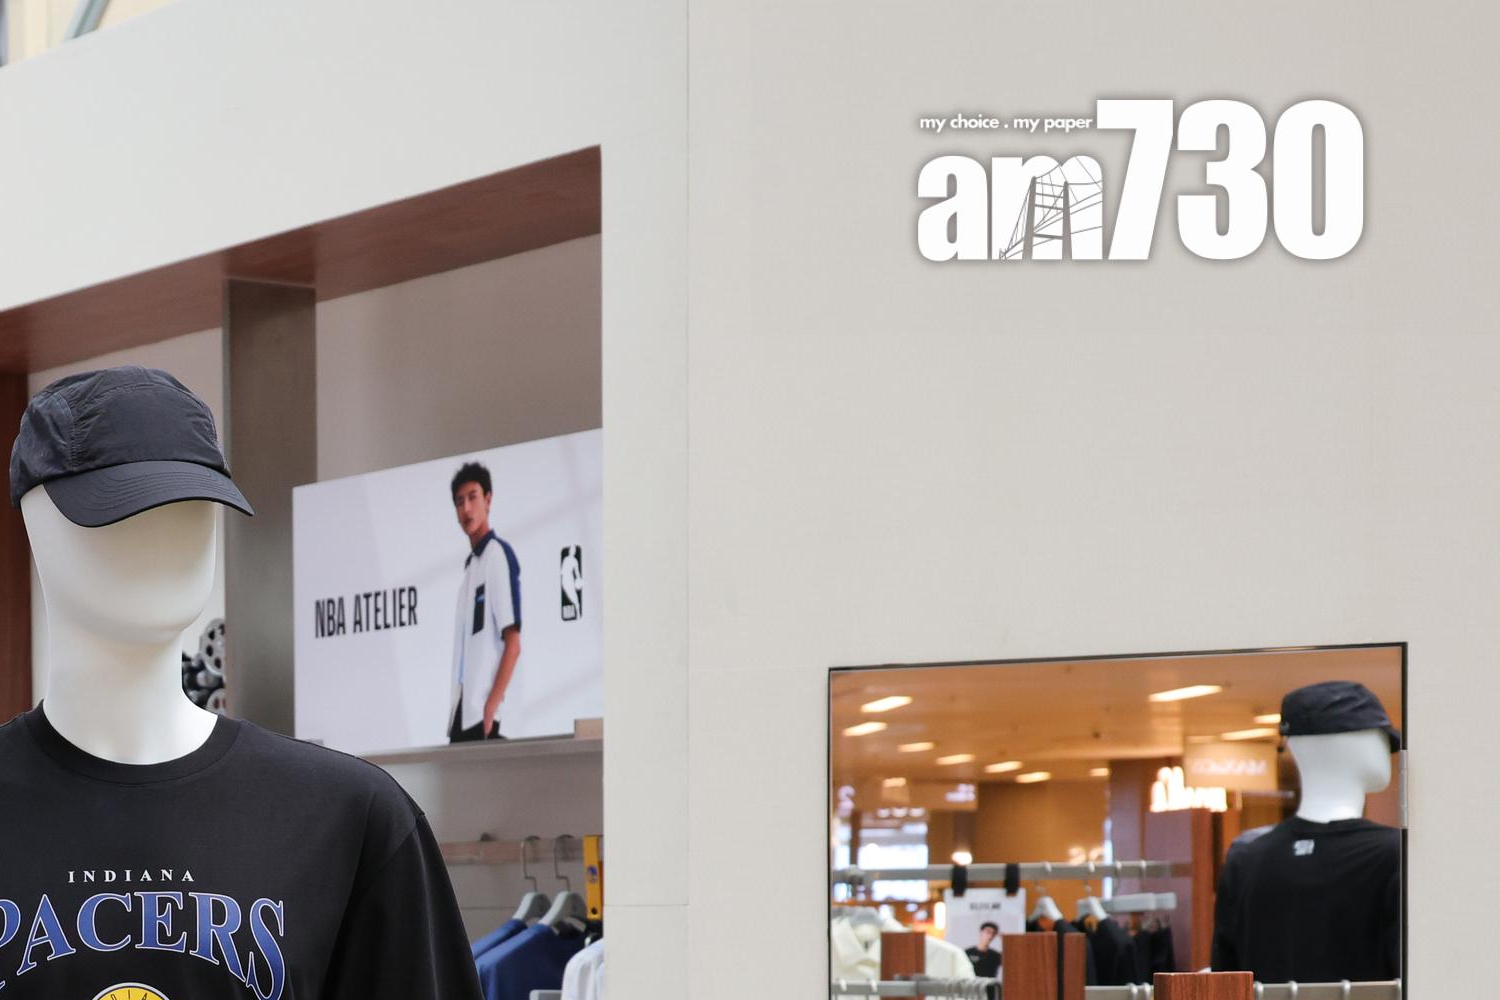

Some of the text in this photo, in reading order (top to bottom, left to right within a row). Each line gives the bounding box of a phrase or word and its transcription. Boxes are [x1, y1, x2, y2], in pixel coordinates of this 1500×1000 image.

[315, 585, 418, 639] NBA ATELIER
[68, 869, 195, 883] INDIANA
